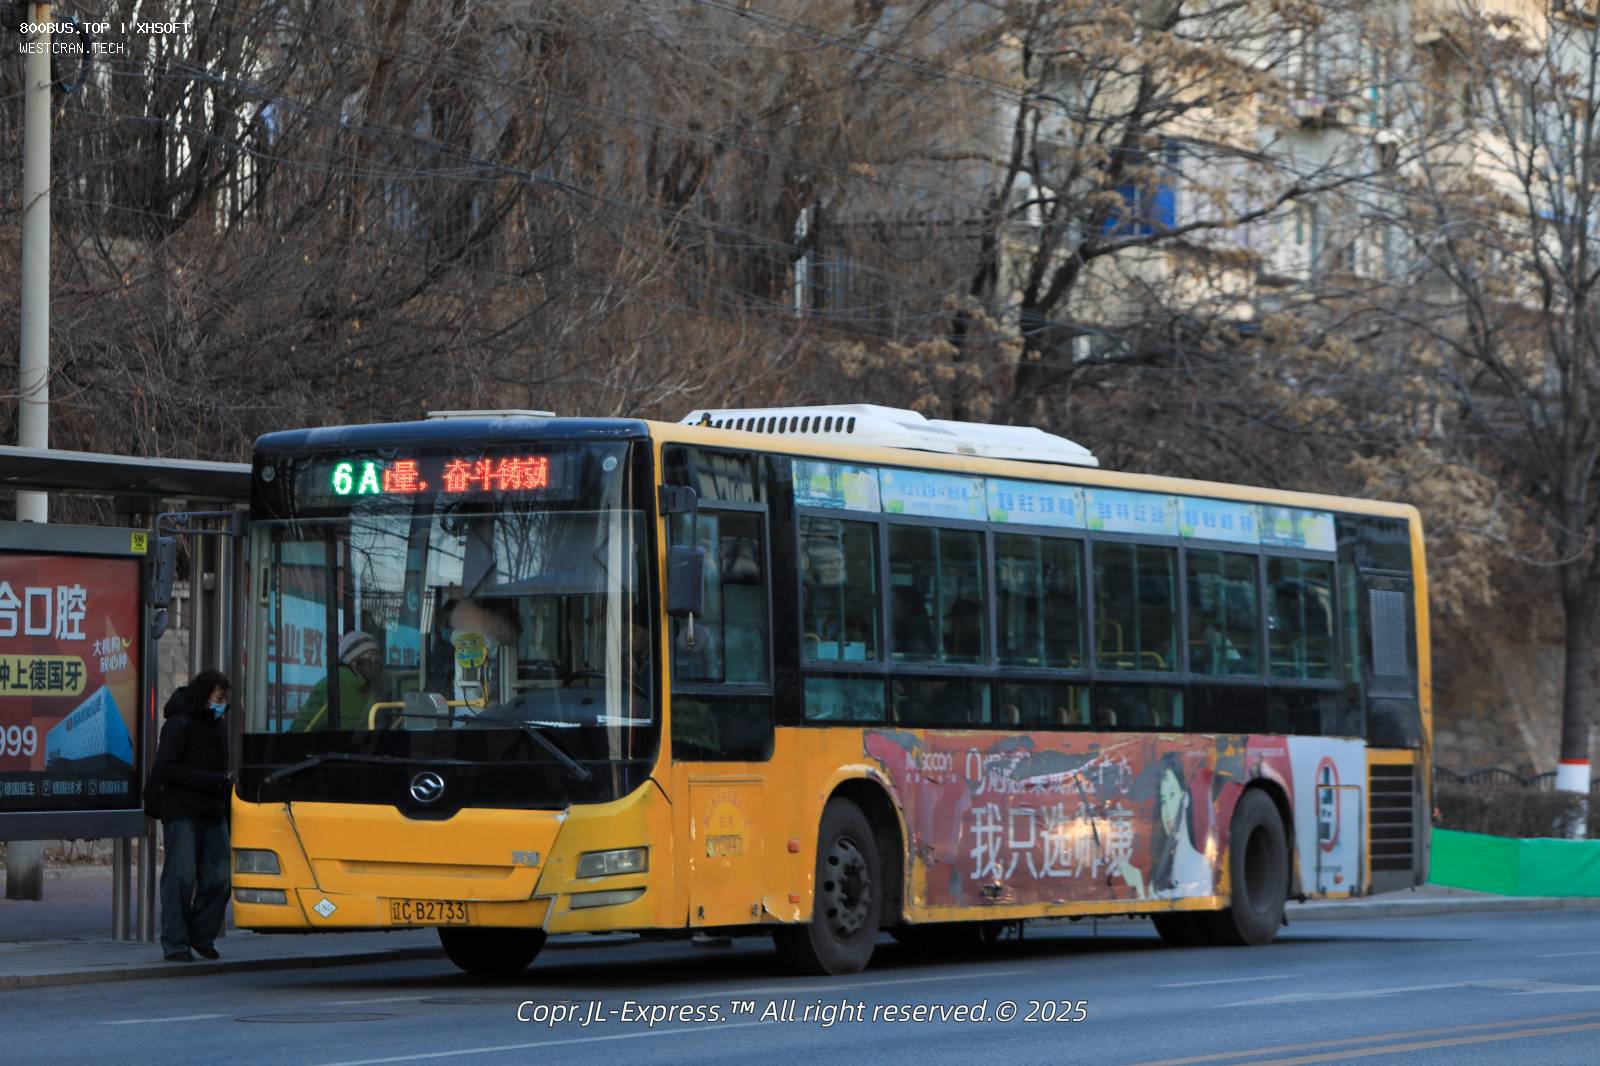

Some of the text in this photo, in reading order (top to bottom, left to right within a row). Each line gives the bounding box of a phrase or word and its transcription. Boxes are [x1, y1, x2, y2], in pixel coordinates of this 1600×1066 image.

[333, 462, 380, 495] 6A
[0, 581, 87, 640] 合口腔
